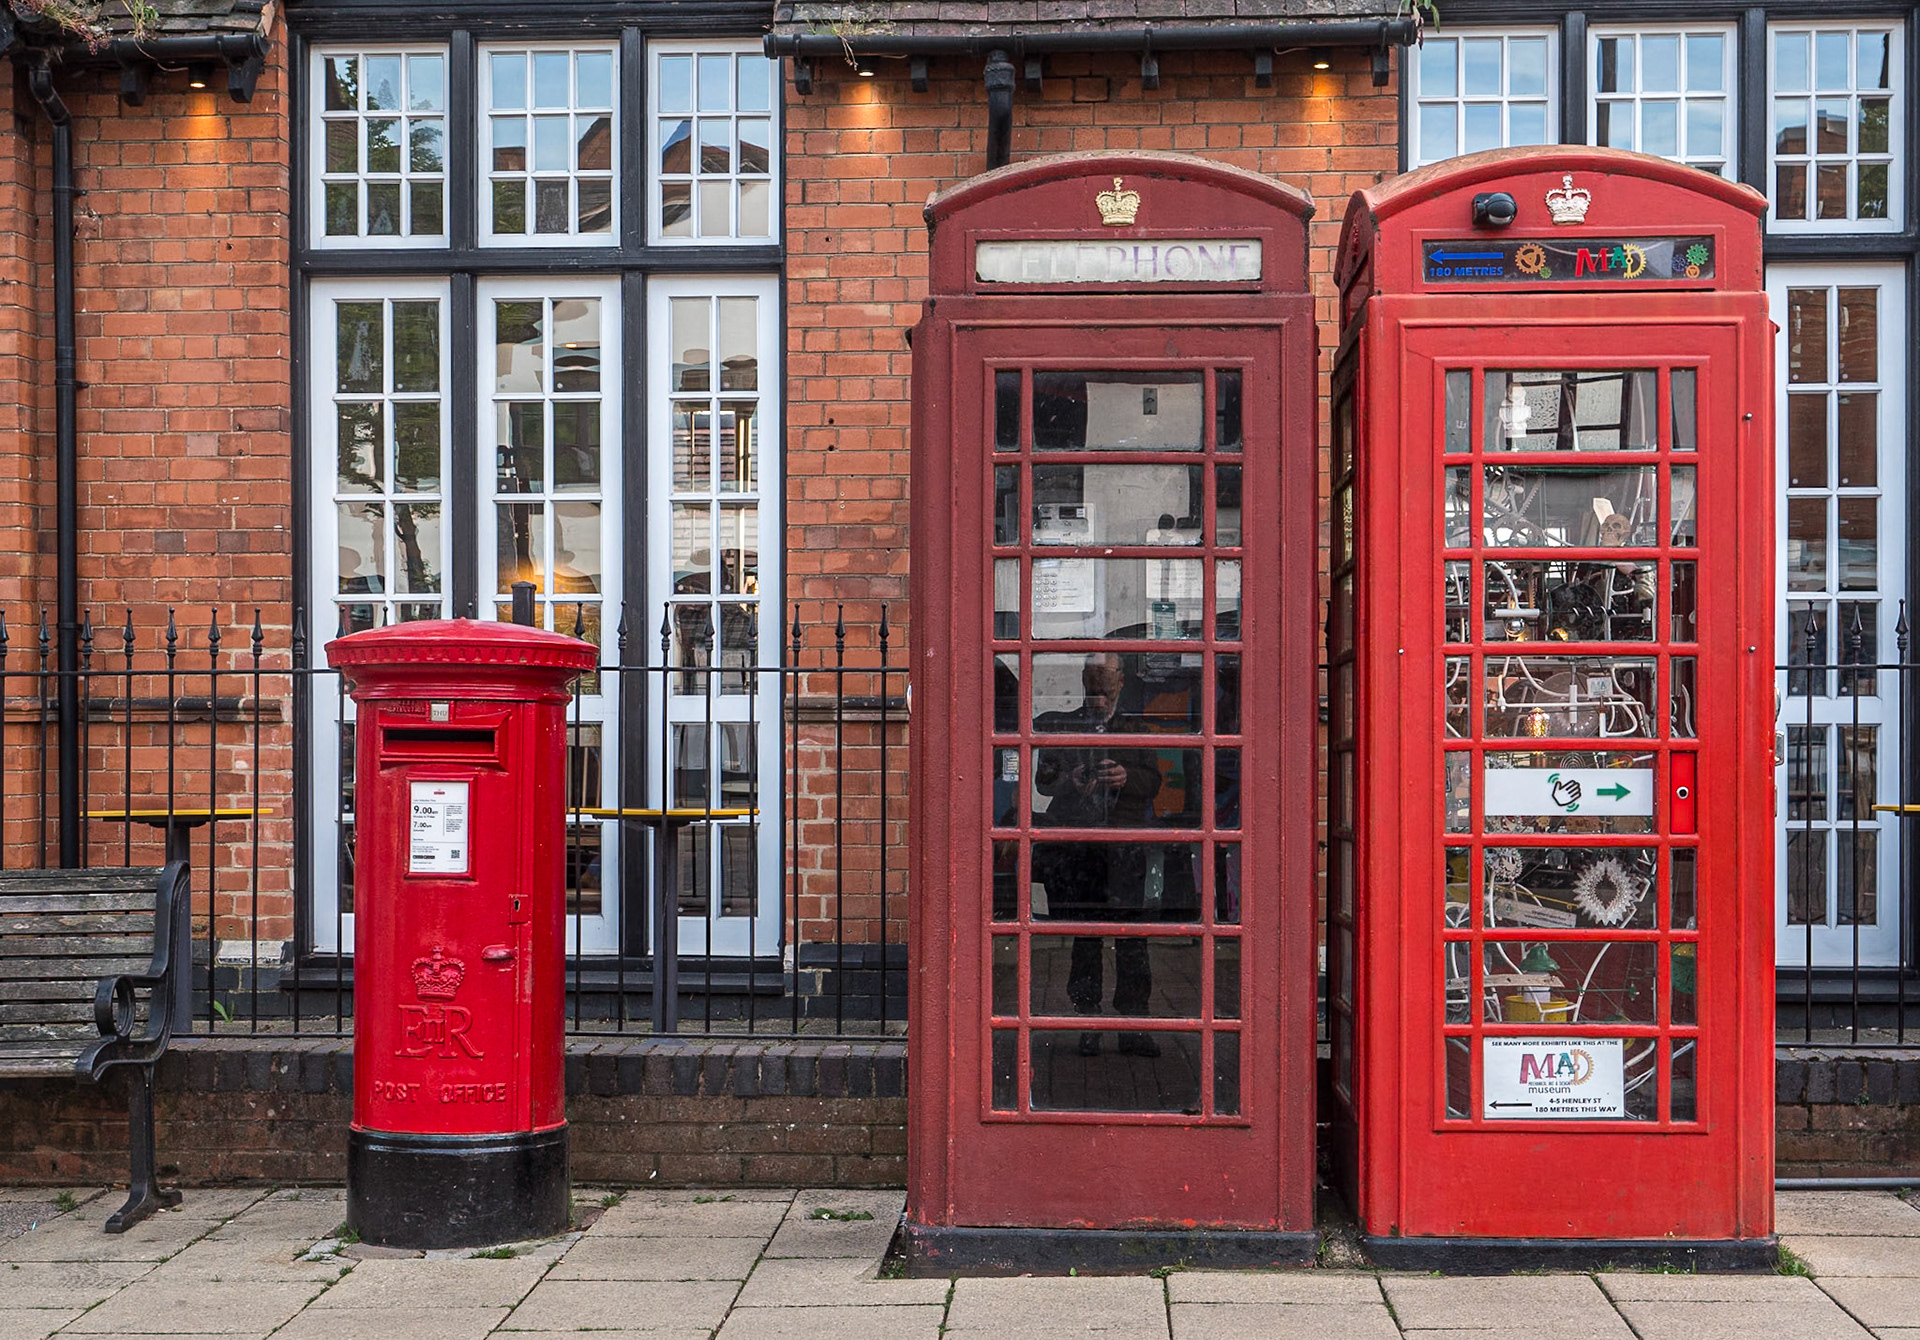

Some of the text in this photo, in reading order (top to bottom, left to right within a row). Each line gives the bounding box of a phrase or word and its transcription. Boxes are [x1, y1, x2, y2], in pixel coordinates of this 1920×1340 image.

[988, 244, 1254, 279] TELEPHONE
[1429, 266, 1503, 277] 180 METRES
[1574, 243, 1647, 279] MAD
[1519, 1048, 1595, 1086] MAD
[374, 1080, 507, 1103] POST OFFICE
[1528, 1086, 1571, 1094] museum
